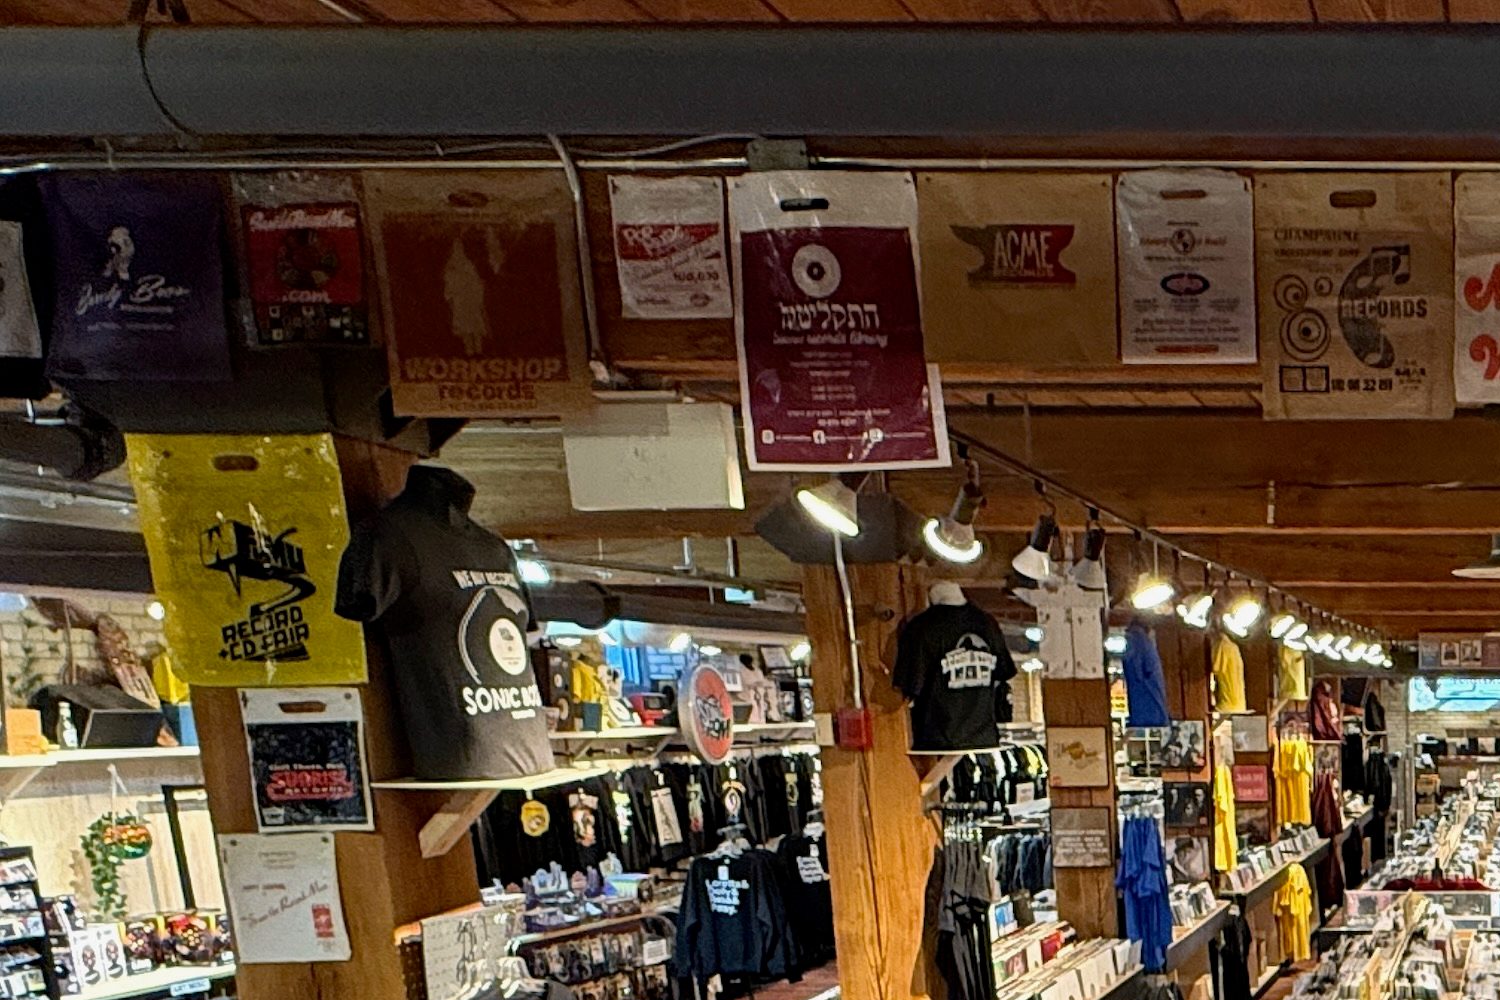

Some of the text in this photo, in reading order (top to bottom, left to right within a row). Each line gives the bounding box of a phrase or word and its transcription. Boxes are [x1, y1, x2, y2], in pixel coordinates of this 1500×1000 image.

[994, 231, 1053, 269] ACME
[1340, 298, 1428, 318] RECORDS
[404, 357, 562, 381] WORKSHOP
[438, 382, 534, 401] records
[222, 606, 303, 643] RECORD
[262, 623, 310, 650] FAIR
[463, 685, 521, 715] SONIC
